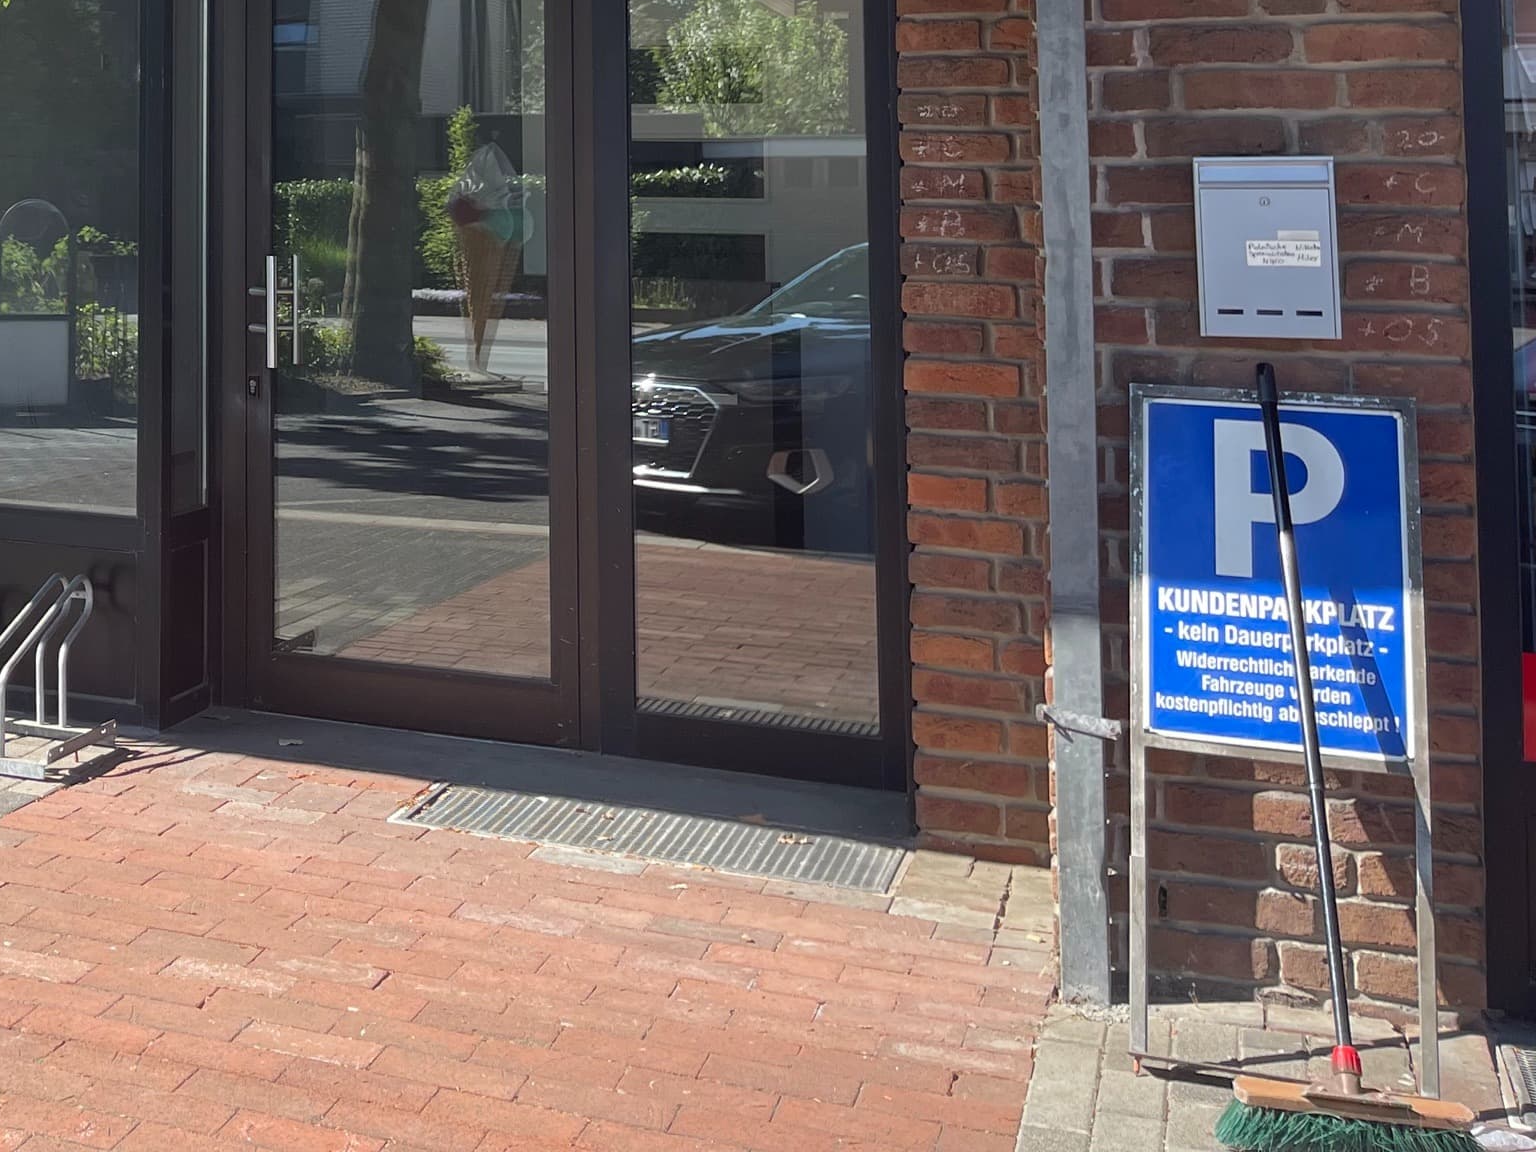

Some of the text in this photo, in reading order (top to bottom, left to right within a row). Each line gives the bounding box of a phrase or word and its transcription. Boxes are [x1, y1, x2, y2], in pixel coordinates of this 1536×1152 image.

[1415, 171, 1437, 194] C
[1410, 263, 1431, 297] B
[1213, 418, 1345, 579] P
[1157, 585, 1395, 632] KUNDENPAKPLATZ
[1178, 619, 1220, 644] kein
[1225, 623, 1375, 658] Dauerprkplatz
[1176, 649, 1377, 686] Widerrechtlich arkende
[1201, 674, 1352, 706] Fahrzeuge wrden
[1155, 690, 1274, 724] kostenpflichtig
[1278, 705, 1390, 734] abschleppt
